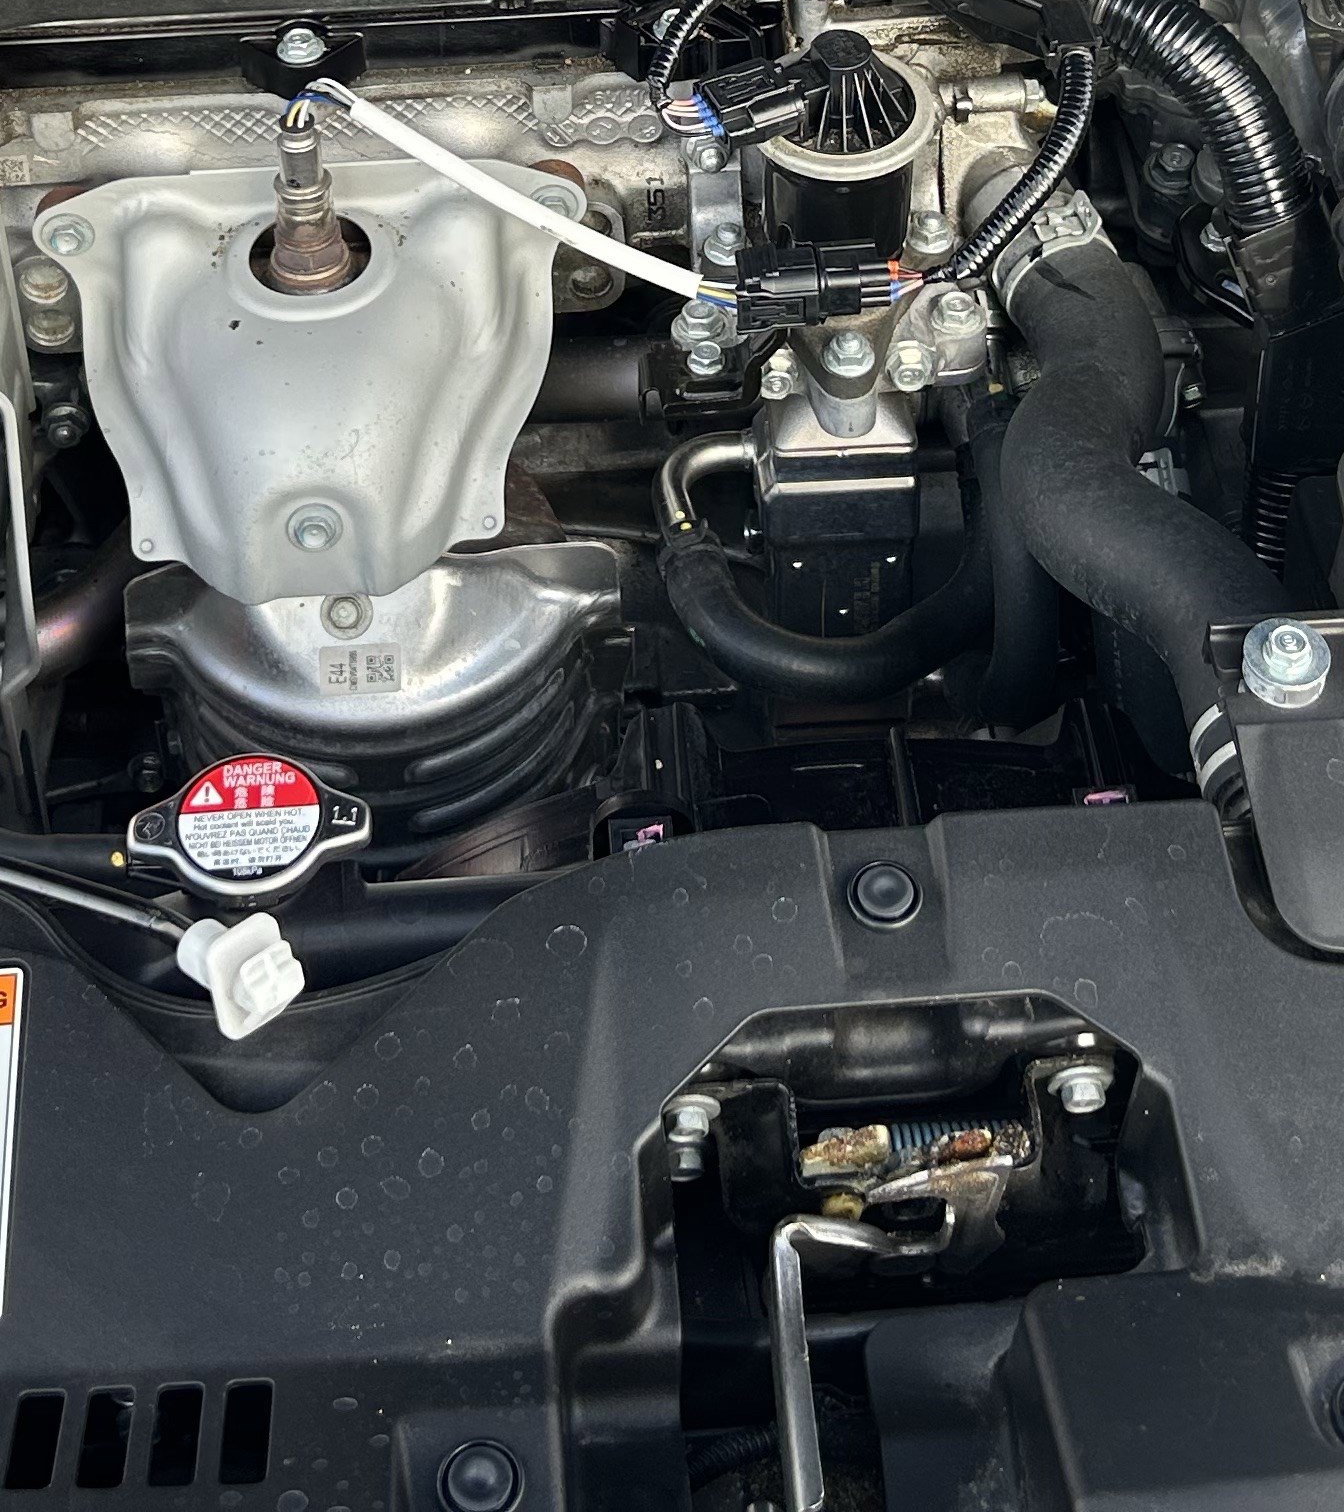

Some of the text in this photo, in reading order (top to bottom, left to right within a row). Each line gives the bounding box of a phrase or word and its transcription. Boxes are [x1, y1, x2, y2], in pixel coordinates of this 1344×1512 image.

[328, 662, 347, 685] E44
[223, 761, 283, 776] DANGER
[223, 771, 296, 788] WARNUNG
[194, 813, 225, 823] NEVER
[227, 811, 252, 820] OPEN
[255, 810, 282, 819] WHEN
[229, 829, 247, 838] PAS
[248, 827, 279, 837] QUAND
[281, 825, 311, 835] CHAUD
